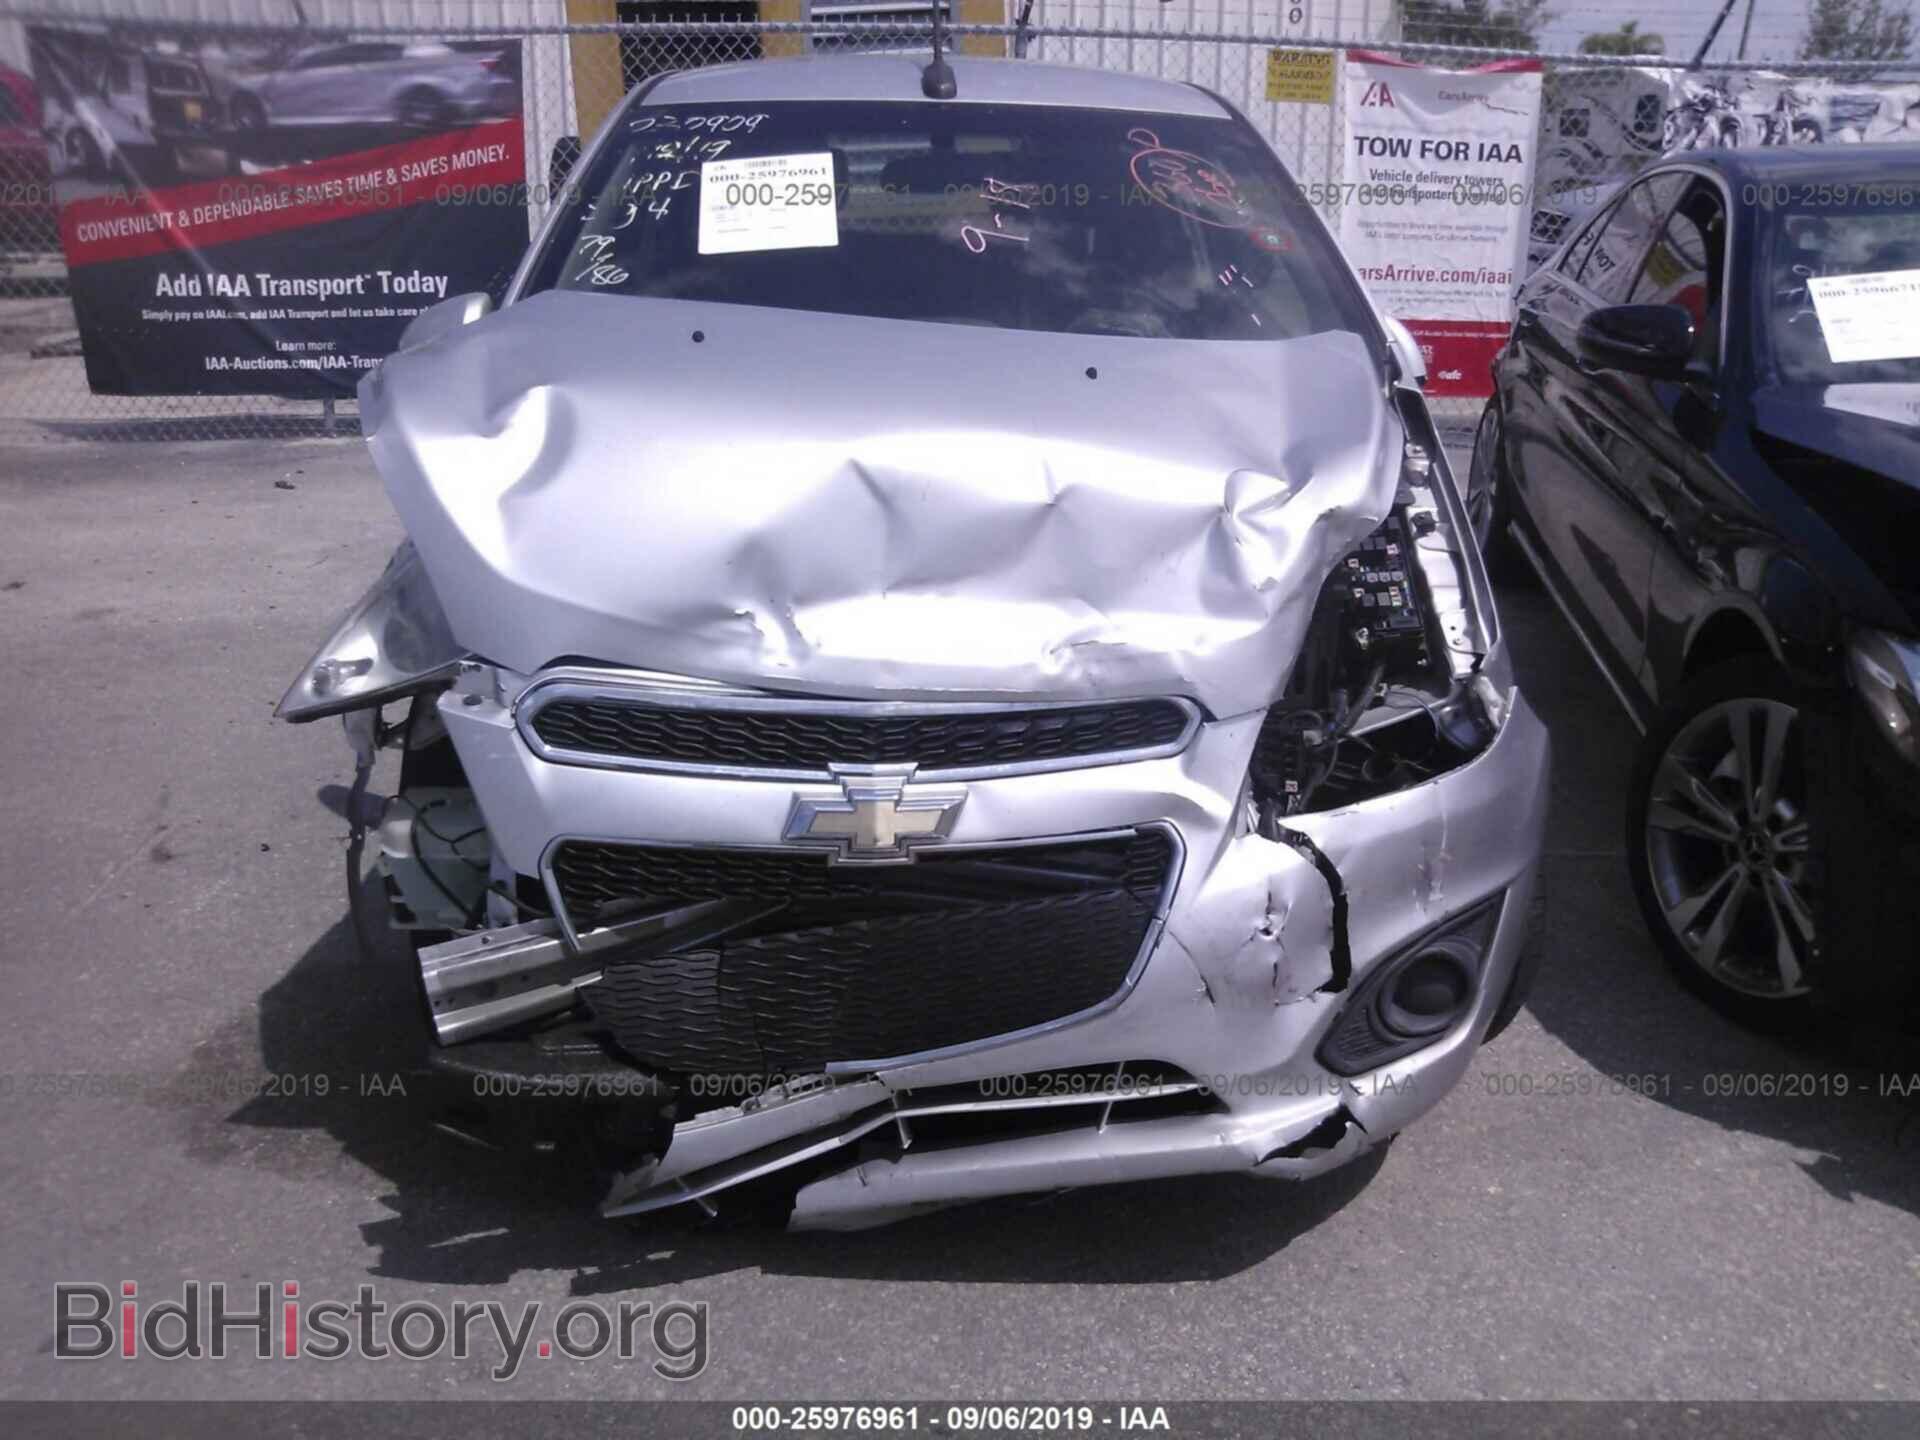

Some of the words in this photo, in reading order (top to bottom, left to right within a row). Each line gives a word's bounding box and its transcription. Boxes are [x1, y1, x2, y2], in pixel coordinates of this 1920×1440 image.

[1354, 136, 1412, 159] TOW
[1419, 139, 1470, 161] FOR
[1477, 143, 1523, 164] IAA
[1369, 168, 1413, 183] Vehicle
[1415, 170, 1463, 186] delivery
[1464, 175, 1504, 187] towers
[76, 212, 174, 243] CONVENIENT
[178, 211, 191, 229] &
[297, 179, 344, 205] SAVES
[347, 168, 383, 193] TIME
[386, 167, 398, 186] &
[401, 156, 449, 183] SAVES
[452, 143, 510, 171] MONEY.
[156, 272, 202, 297] Add
[207, 273, 251, 297] IAA
[376, 269, 449, 299] Today
[1357, 263, 1513, 285] arsArrive.com/iaai
[142, 308, 173, 322] Simply
[269, 309, 286, 319] IAA
[287, 308, 329, 321] Transport
[275, 340, 306, 352] Learn
[307, 341, 337, 351] more:
